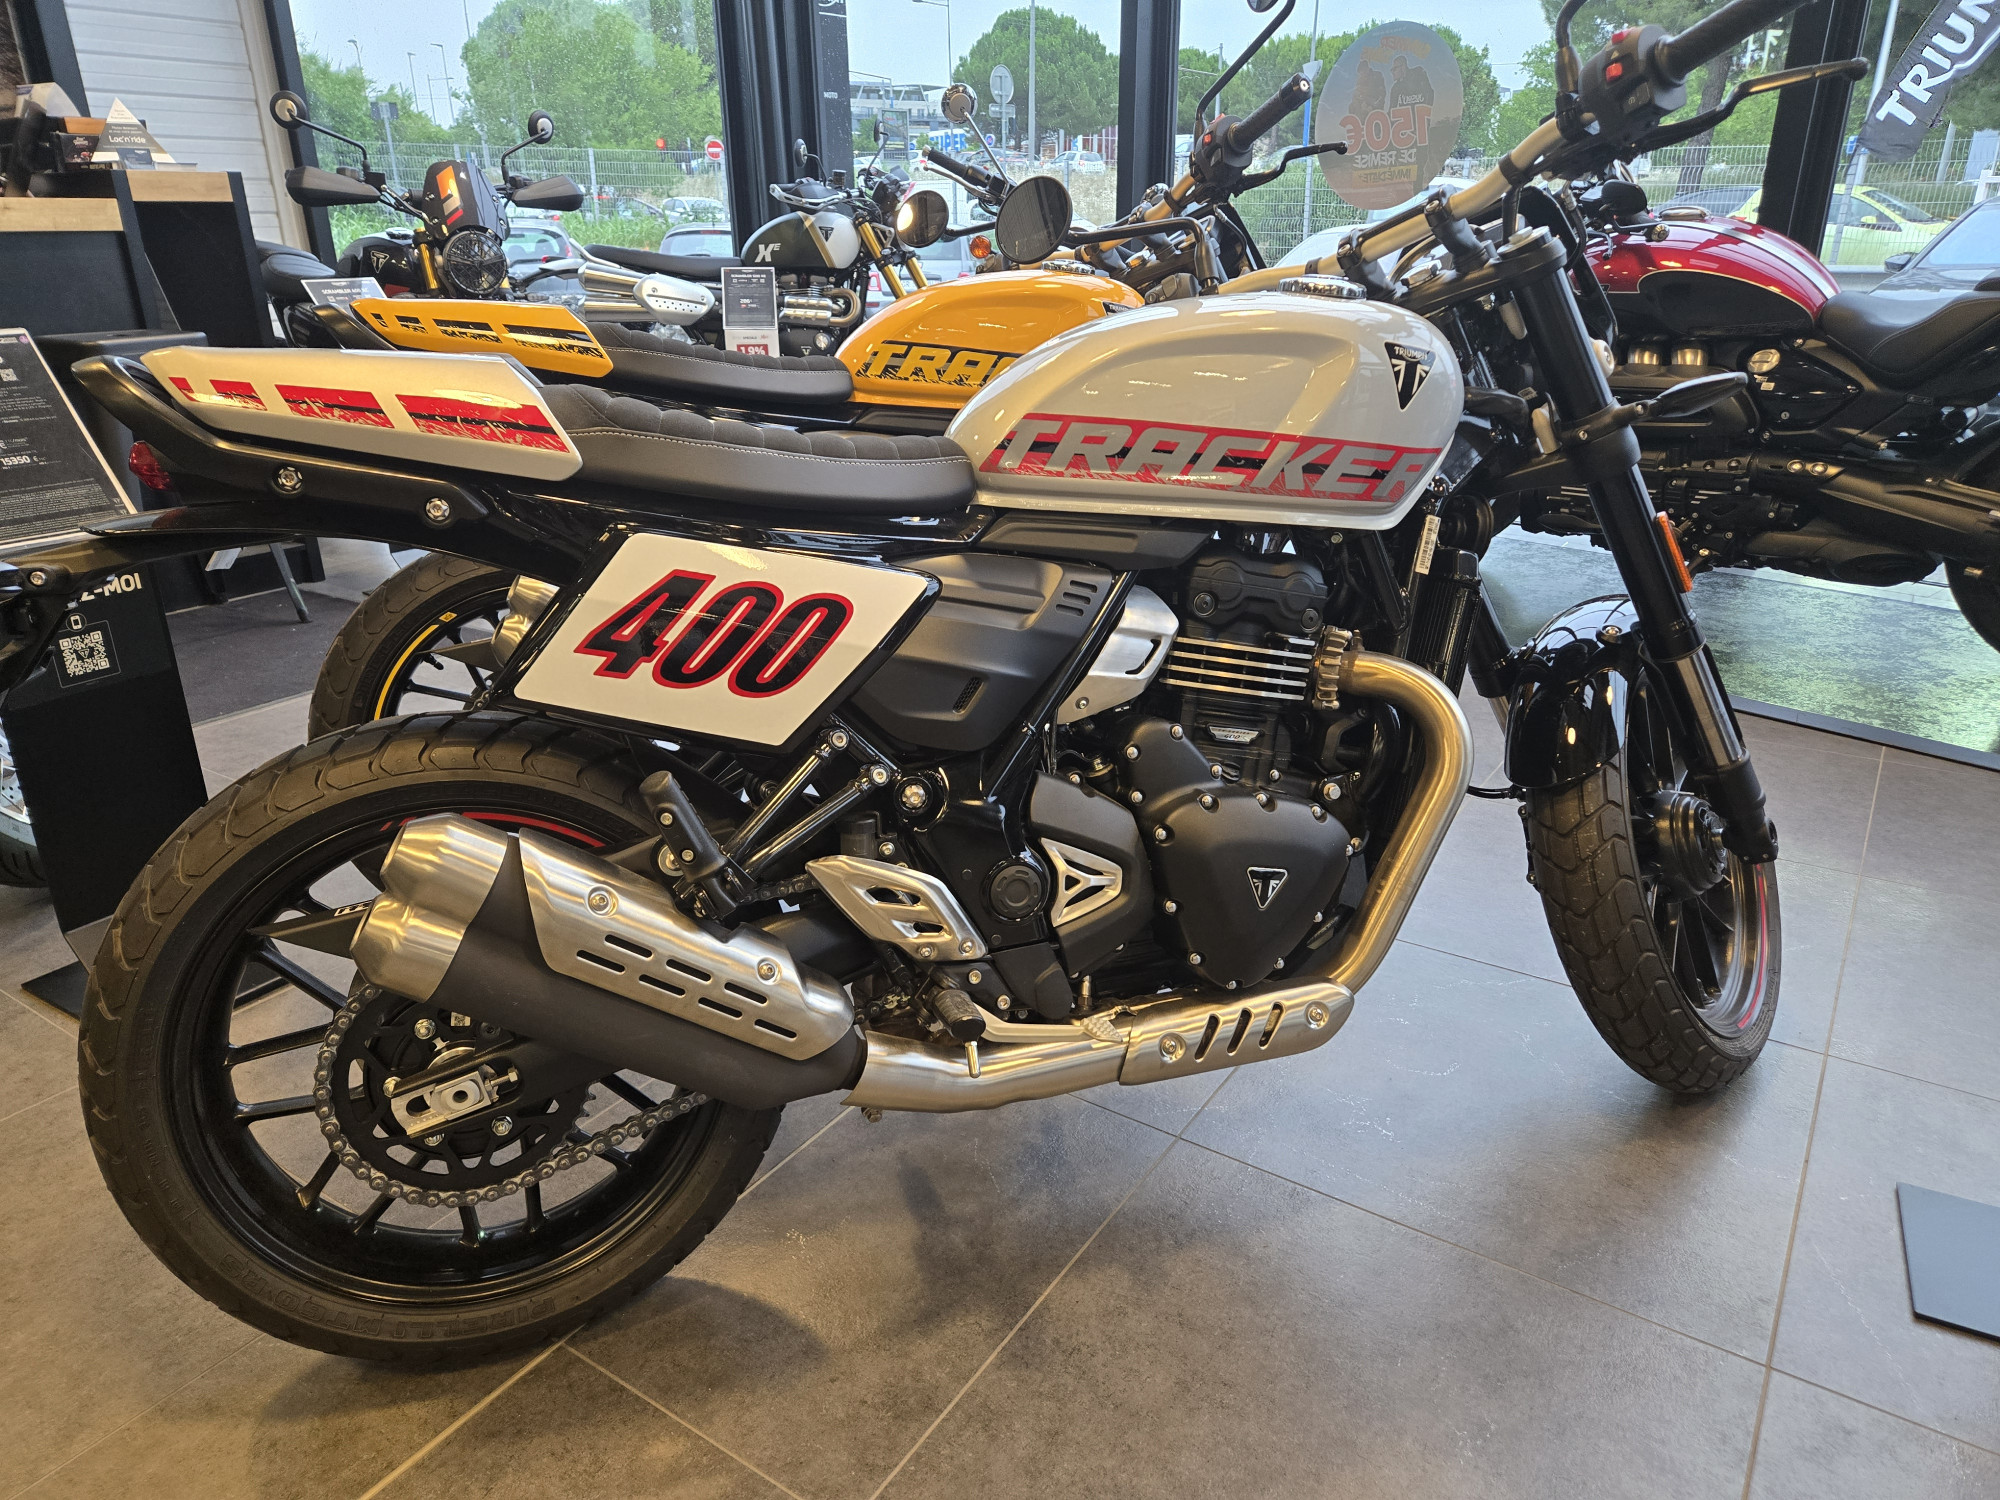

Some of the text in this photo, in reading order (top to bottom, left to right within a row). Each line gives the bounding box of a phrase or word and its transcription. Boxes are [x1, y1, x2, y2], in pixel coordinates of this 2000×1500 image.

[1393, 345, 1428, 361] TRIUMPH
[1001, 417, 1440, 499] TRACKER
[574, 569, 854, 698] 400
